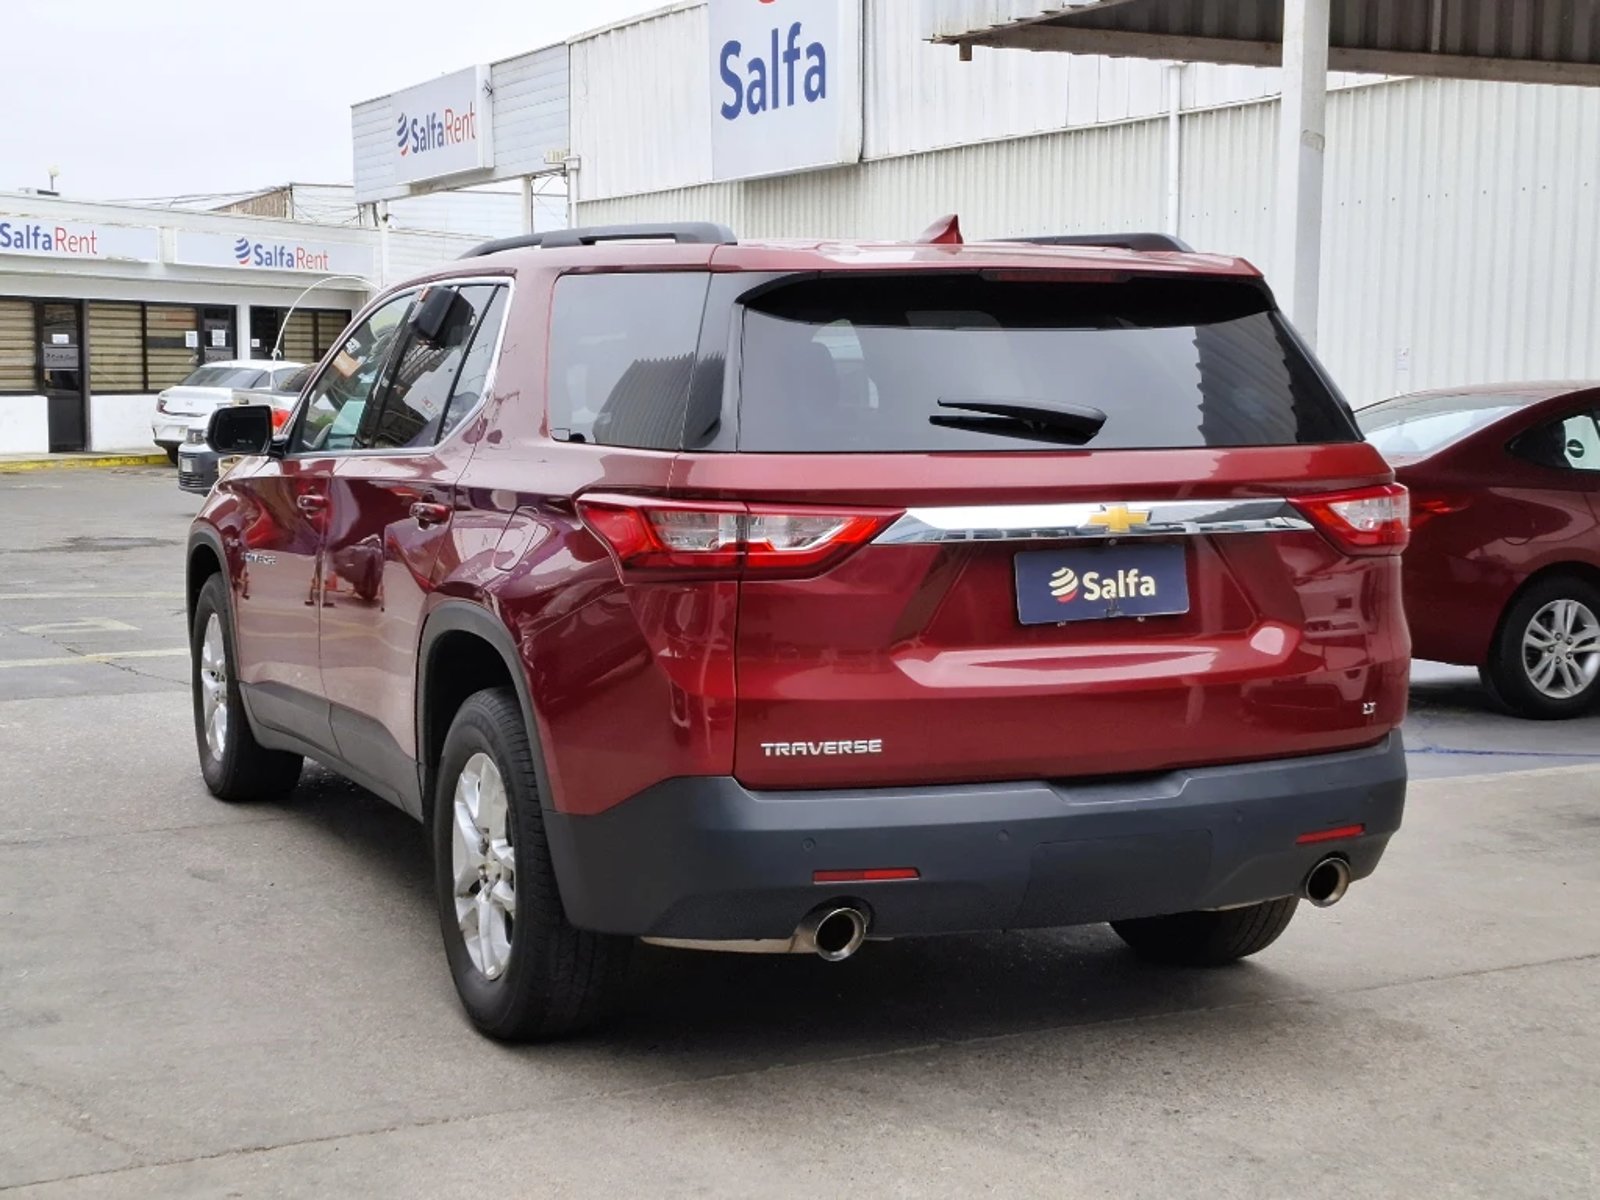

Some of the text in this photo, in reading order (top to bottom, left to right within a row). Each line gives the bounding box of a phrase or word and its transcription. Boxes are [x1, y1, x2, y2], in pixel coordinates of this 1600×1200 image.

[720, 21, 827, 121] Salfa
[411, 101, 475, 153] SalfaRent
[0, 222, 98, 255] SalfaRent
[254, 243, 329, 271] SalfaRent
[1082, 568, 1156, 601] Salfa
[760, 739, 882, 756] TRAVERSE
